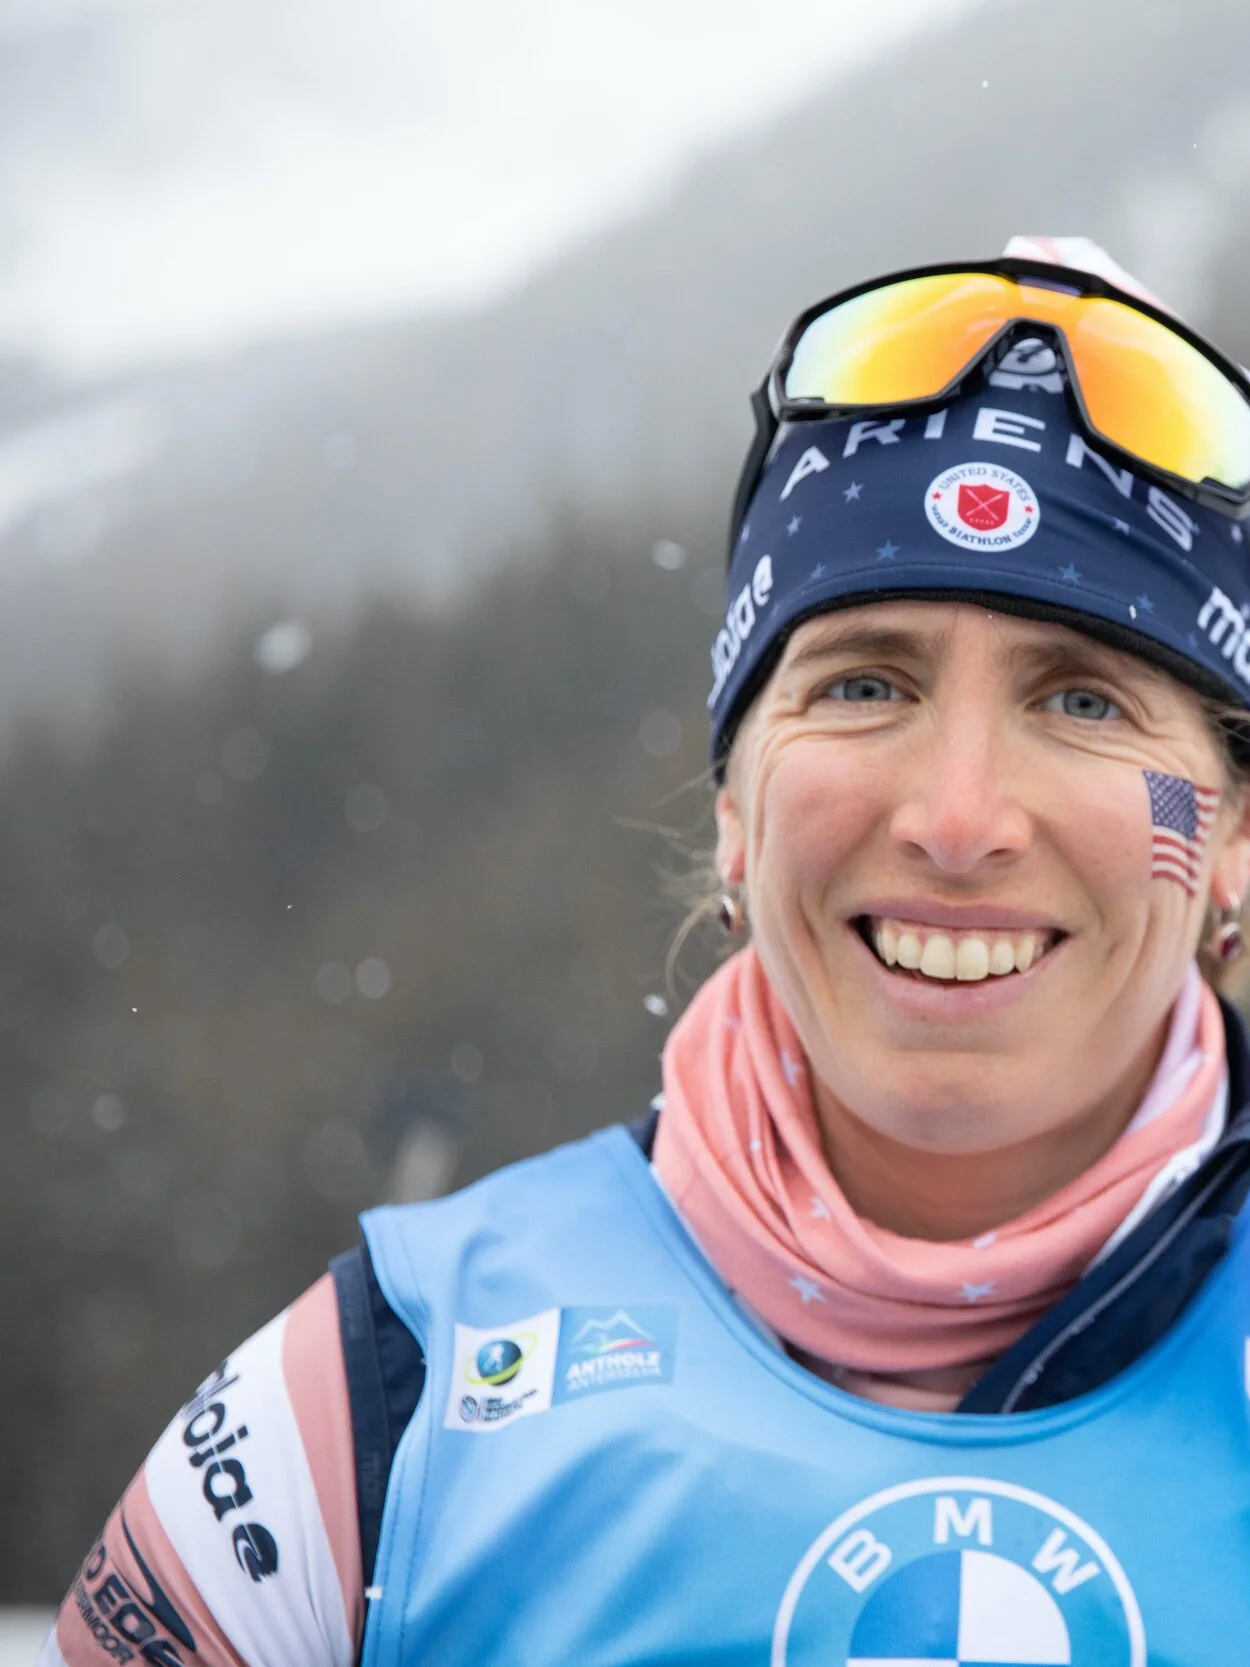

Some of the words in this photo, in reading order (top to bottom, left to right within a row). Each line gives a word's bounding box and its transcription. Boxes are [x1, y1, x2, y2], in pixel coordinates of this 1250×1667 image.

[780, 407, 1193, 552] ARIENS
[939, 467, 987, 490] UNITED
[991, 469, 1030, 501] STATES
[948, 526, 1012, 545] BIATHLON
[827, 1496, 1101, 1595] BMW
